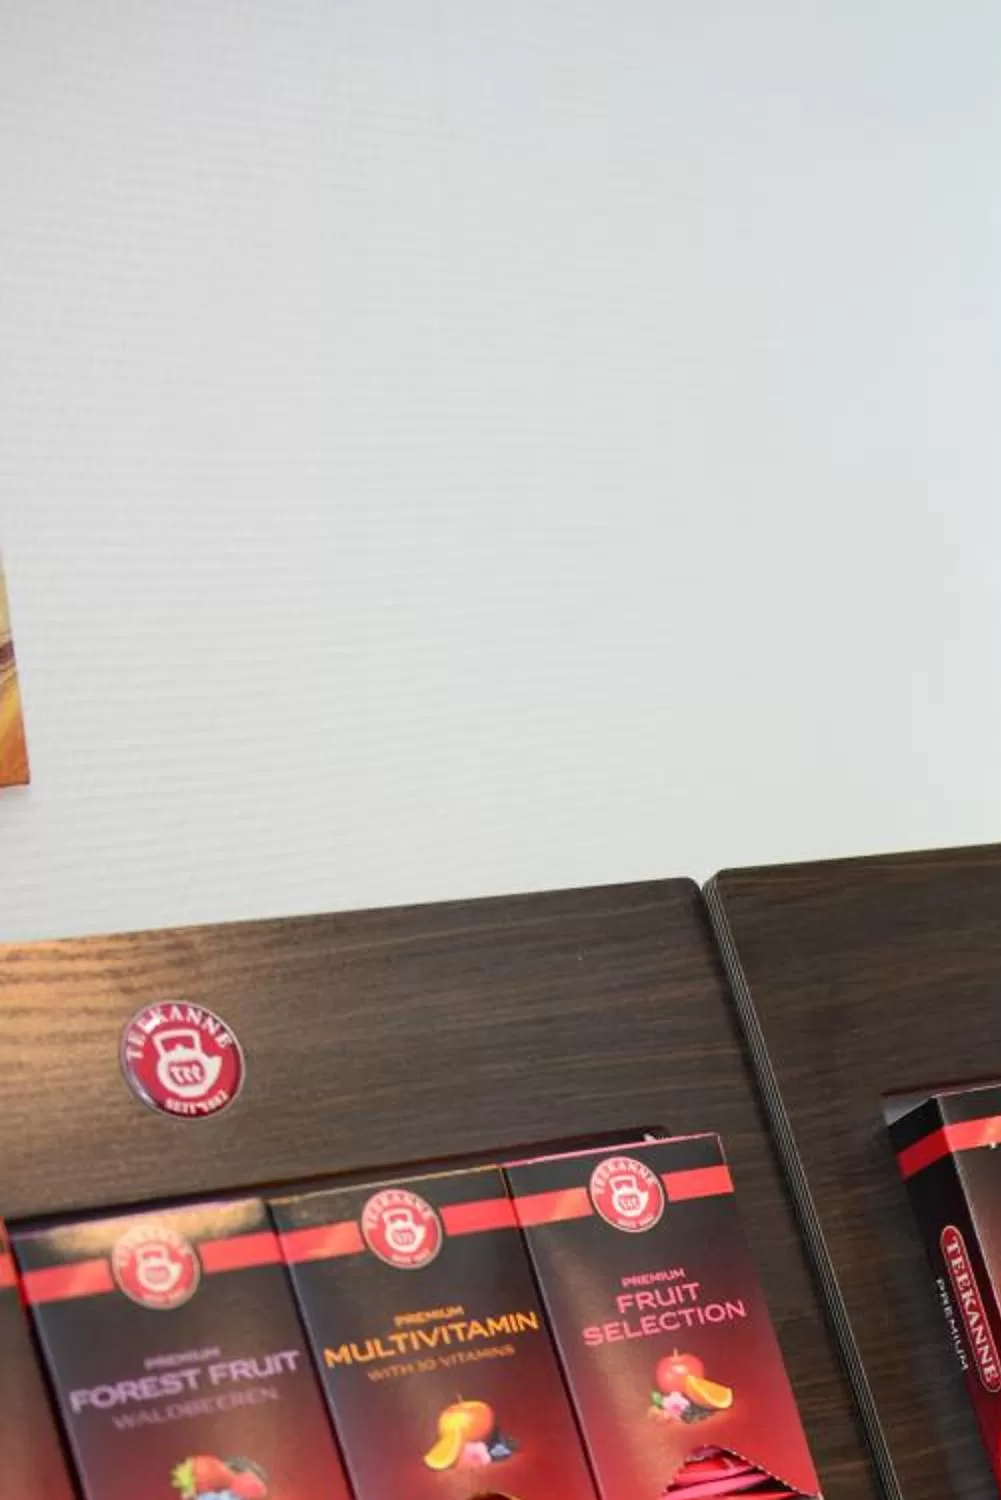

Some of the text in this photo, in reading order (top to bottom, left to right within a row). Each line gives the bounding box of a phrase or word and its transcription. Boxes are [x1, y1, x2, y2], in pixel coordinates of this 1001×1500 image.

[615, 1281, 702, 1314] FRUIT
[620, 1267, 686, 1289] PREMIUM
[582, 1300, 748, 1347] SELECTION
[945, 1236, 999, 1384] TEEKANNE
[323, 1311, 539, 1368] MULTIVITAMIN
[70, 1350, 300, 1414] FOREST FRUIT
